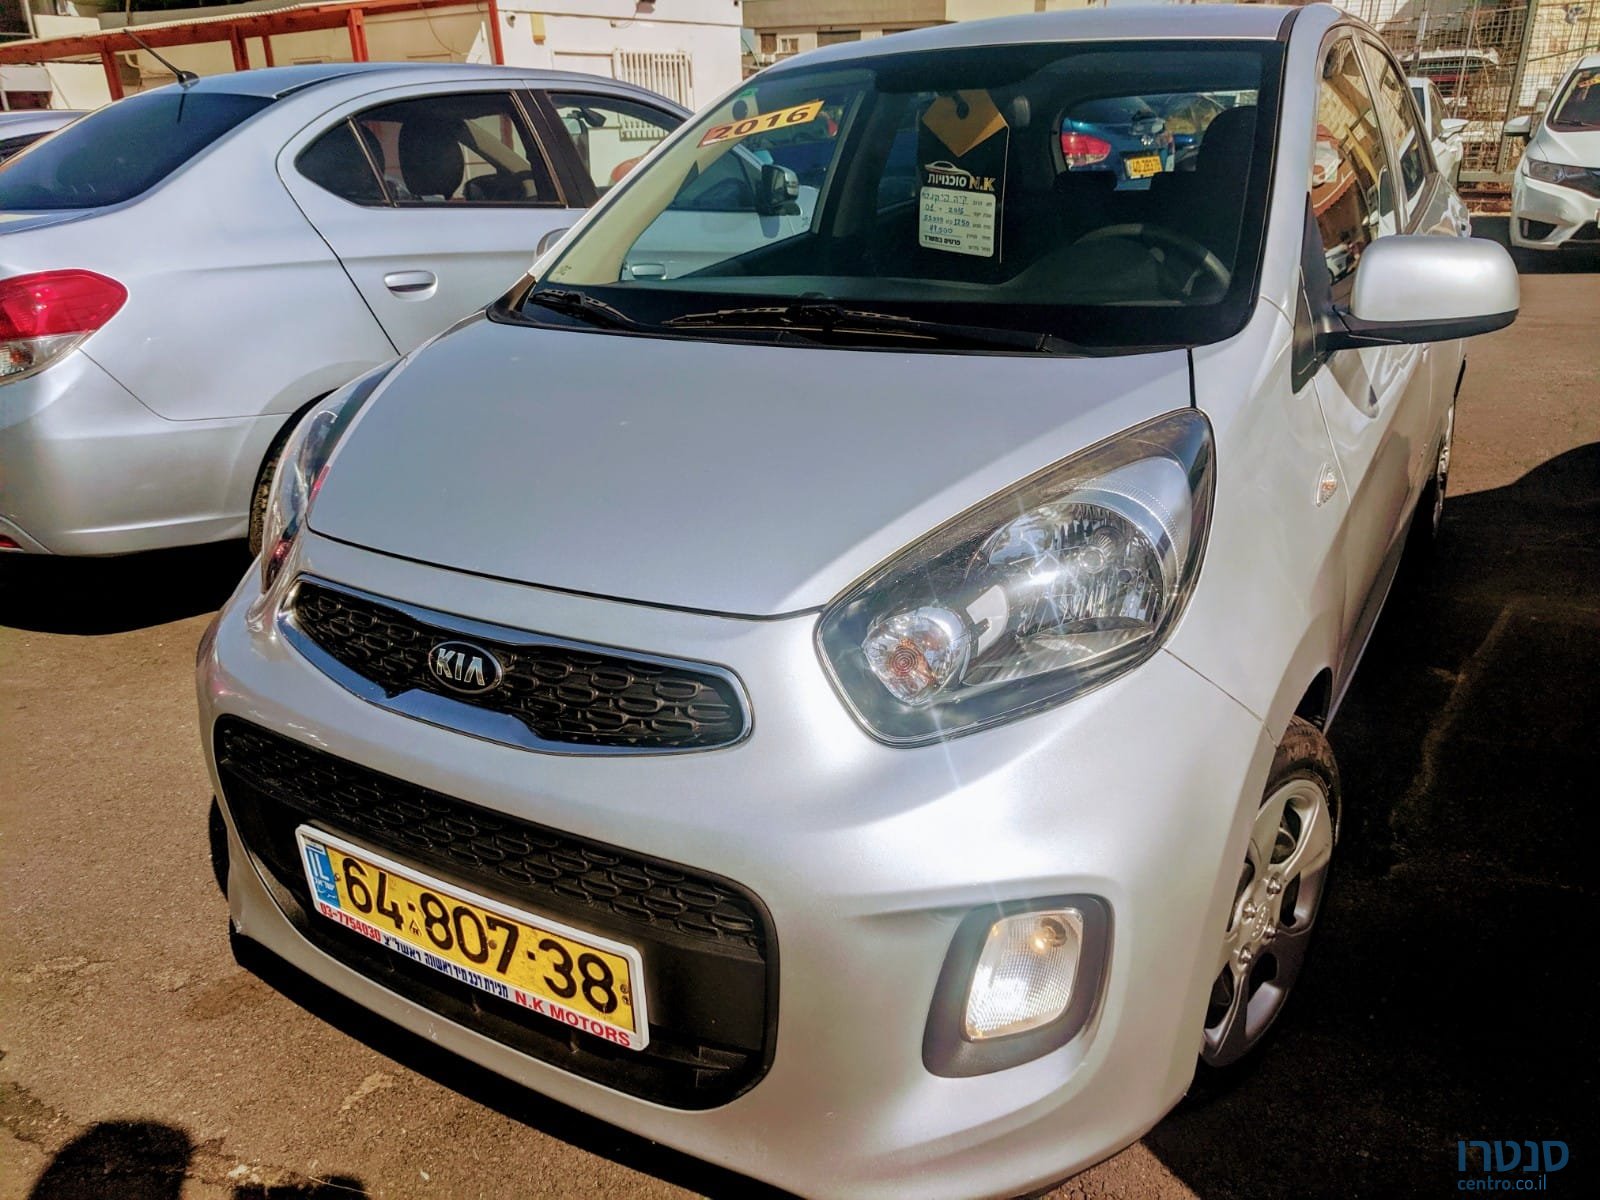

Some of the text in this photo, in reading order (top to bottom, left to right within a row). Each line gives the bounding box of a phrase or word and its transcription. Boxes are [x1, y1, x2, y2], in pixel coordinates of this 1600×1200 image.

[714, 106, 811, 139] 2016
[927, 173, 967, 187] סוכנויות
[969, 176, 996, 191] N.K
[436, 648, 486, 686] KIA
[308, 848, 330, 881] IL
[319, 901, 382, 942] 03-7754030
[483, 978, 509, 999] מכירת
[514, 989, 631, 1048] N.K MOTORS
